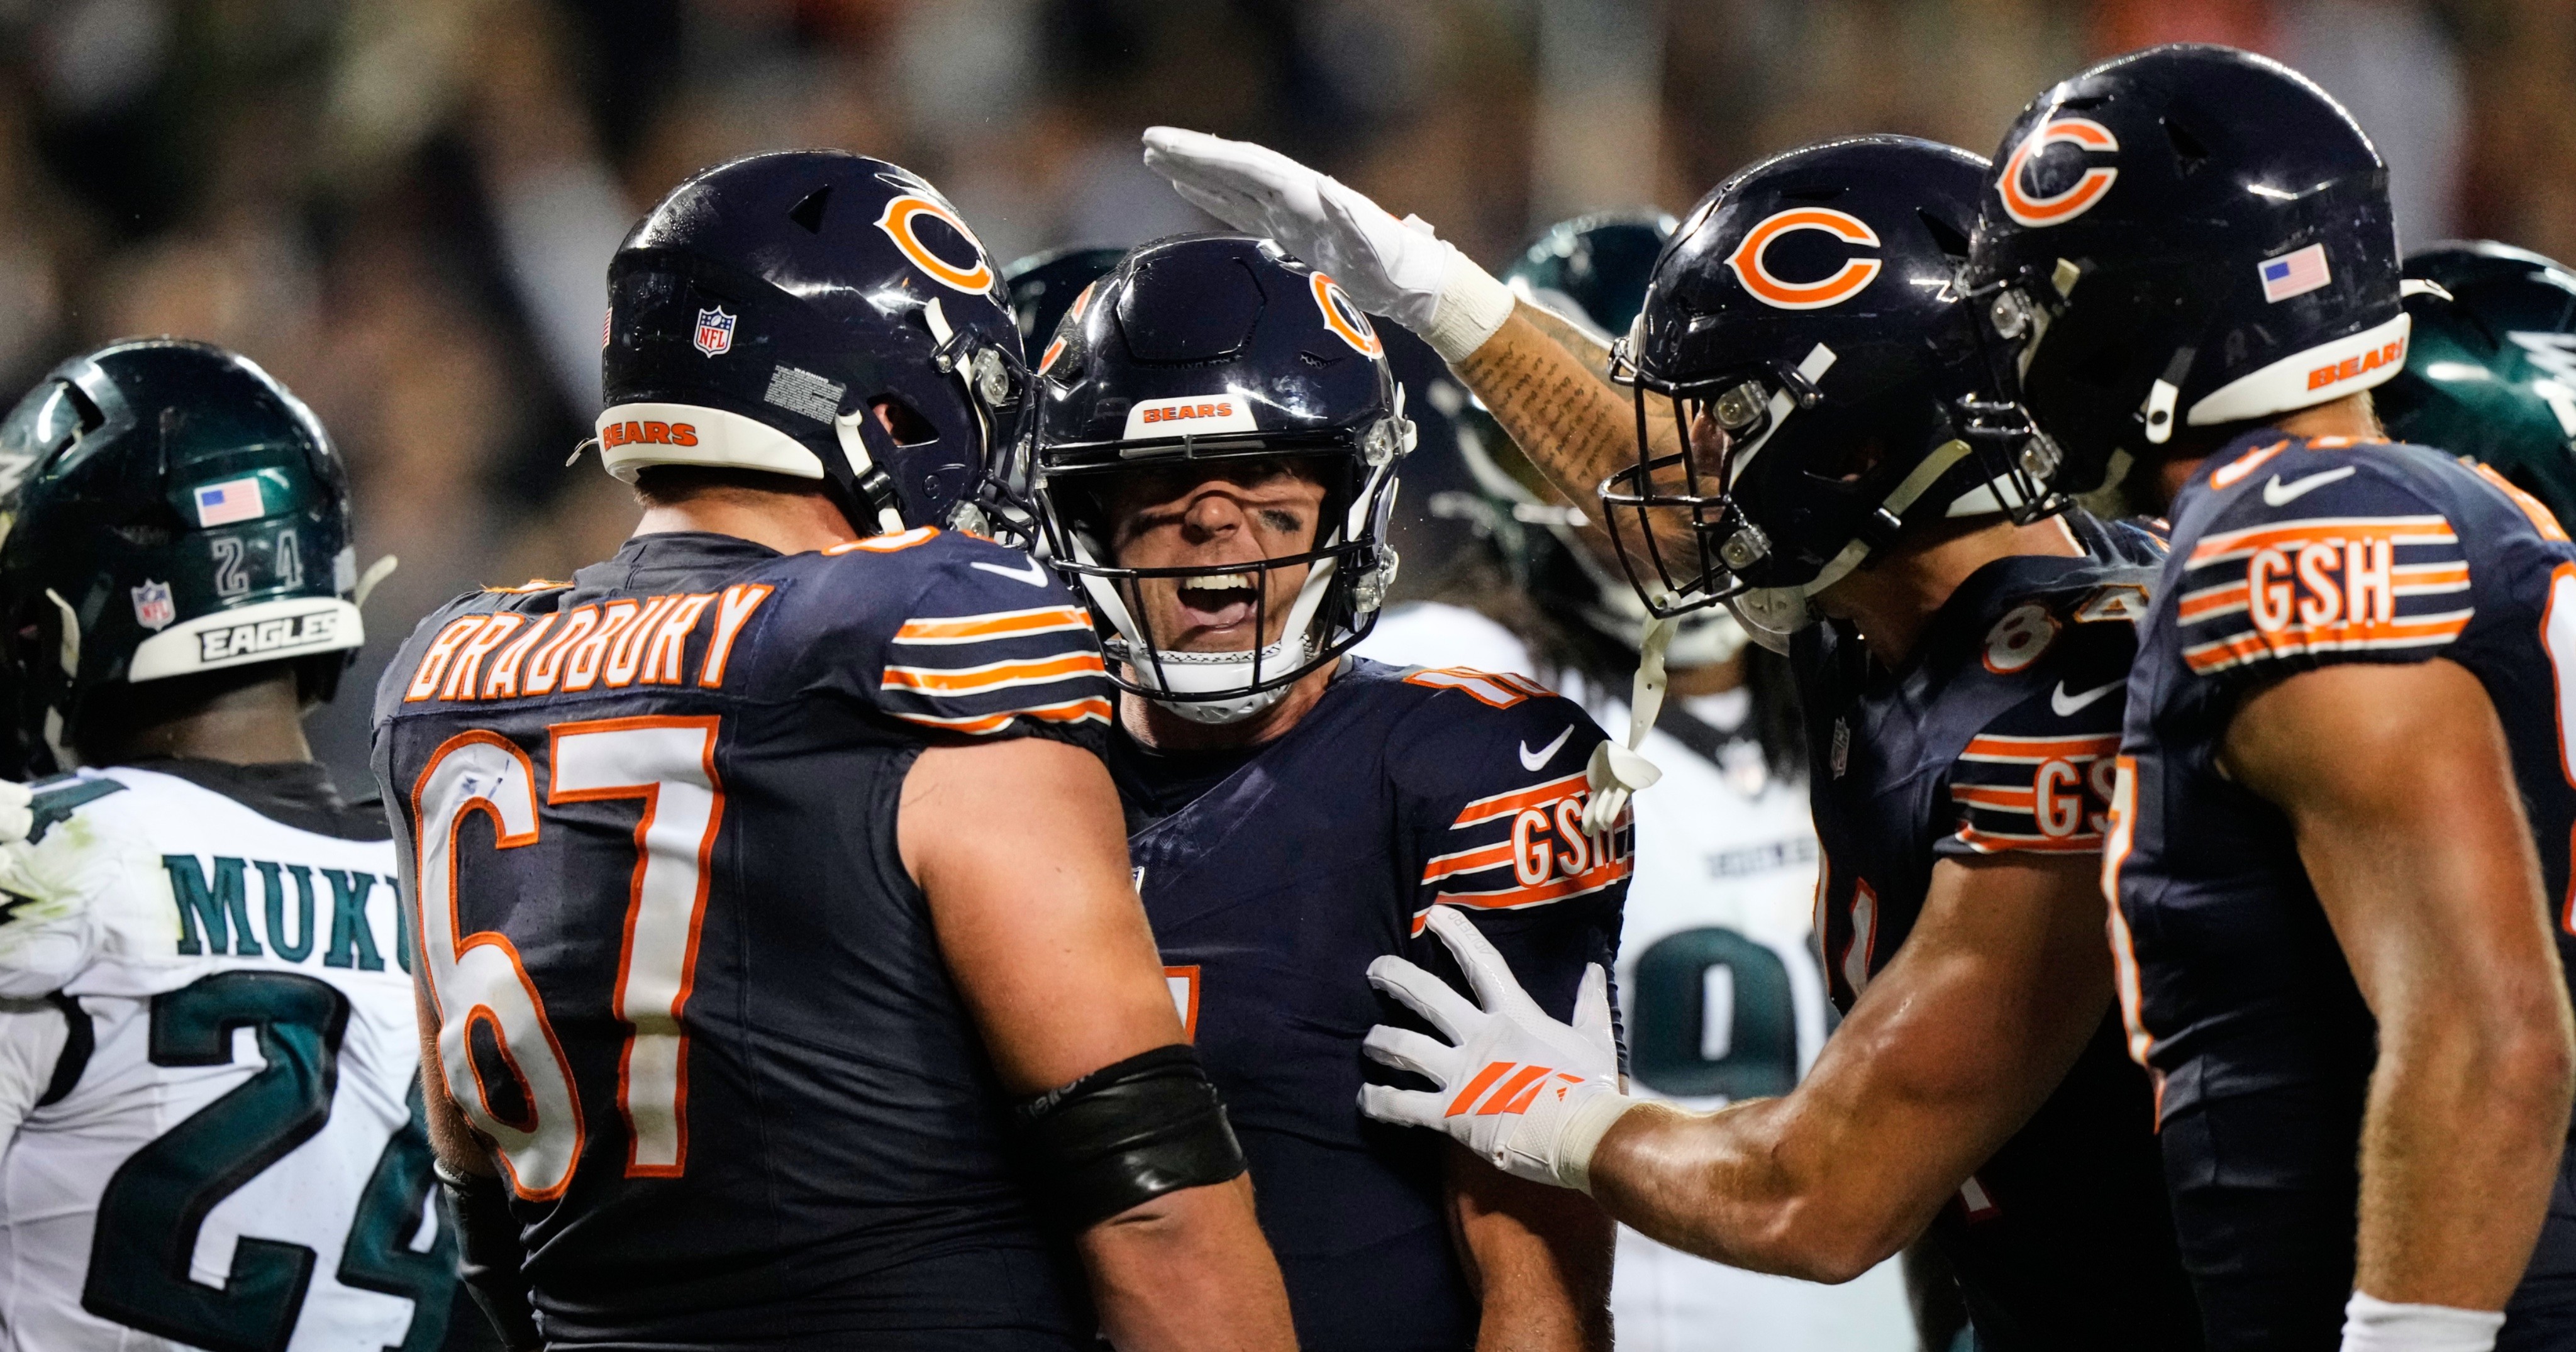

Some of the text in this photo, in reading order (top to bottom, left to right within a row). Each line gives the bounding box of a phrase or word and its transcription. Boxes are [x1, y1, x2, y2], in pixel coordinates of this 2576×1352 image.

[698, 326, 726, 349] NFL
[794, 367, 829, 384] WARNING
[1143, 402, 1233, 424] BEARS
[602, 420, 699, 452] BEARS
[2247, 538, 2395, 634] GSH
[196, 609, 340, 662] EAGLES
[404, 582, 775, 703] BRADBURY
[1447, 911, 1494, 955] ADIZERO
[411, 714, 725, 1204] 67
